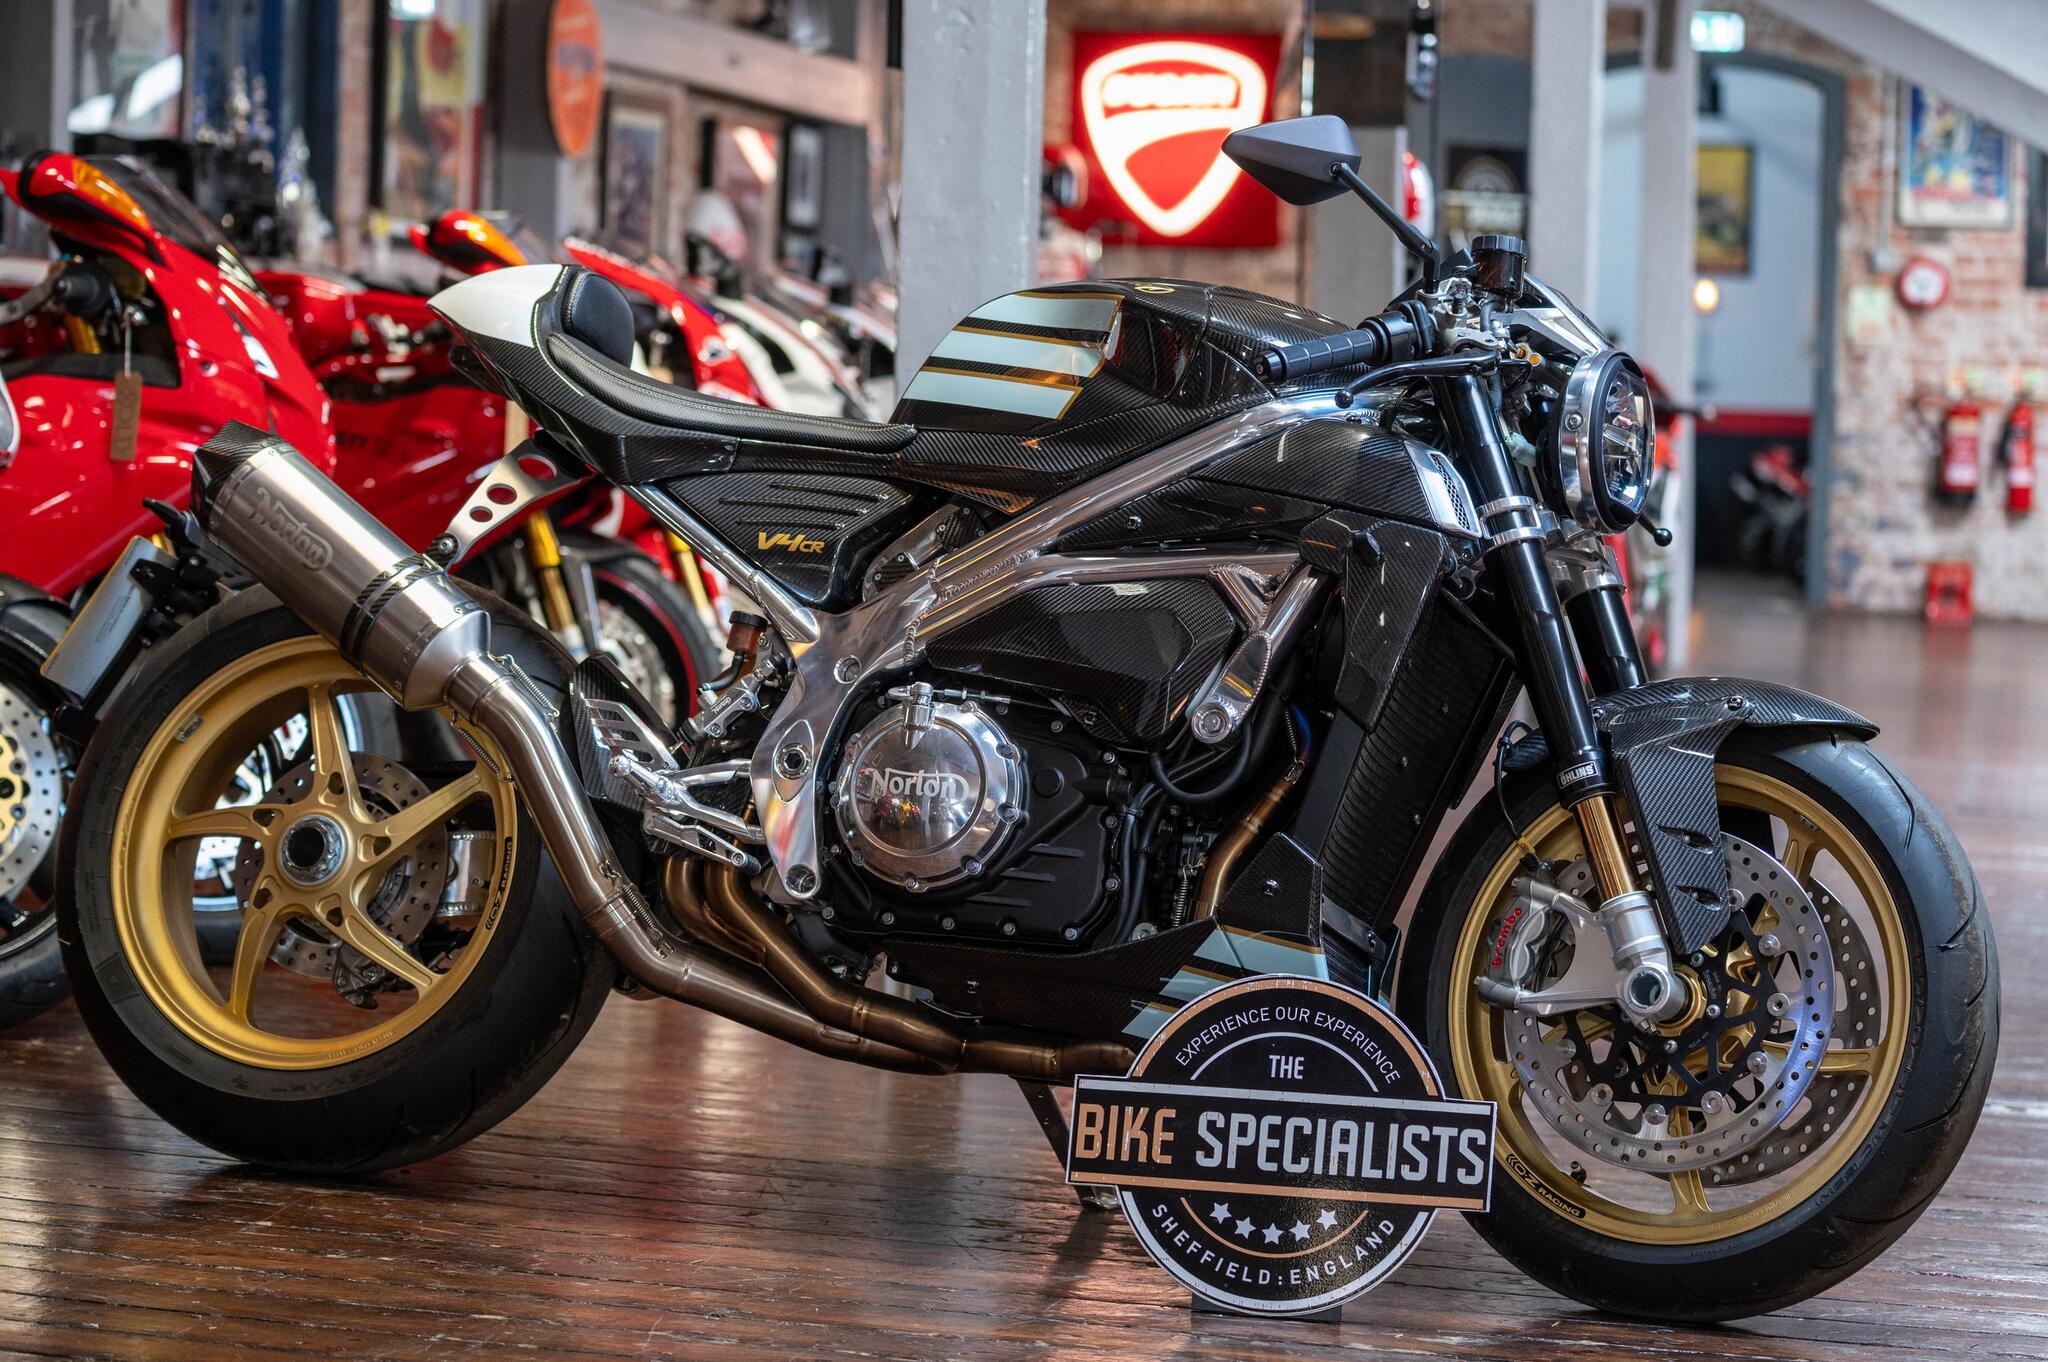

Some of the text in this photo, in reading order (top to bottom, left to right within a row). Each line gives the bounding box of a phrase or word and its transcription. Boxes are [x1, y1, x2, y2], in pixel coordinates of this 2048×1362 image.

[248, 486, 333, 570] Norton
[758, 532, 825, 553] V4CR
[864, 767, 970, 804] Norton
[1491, 907, 1522, 967] brembo
[1175, 1006, 1401, 1085] EXPERIENCE OUR EXPERIENCE
[1269, 1054, 1305, 1080] THE
[1075, 1103, 1487, 1185] BIKE SPECIALISTS
[1538, 1187, 1581, 1217] RACING
